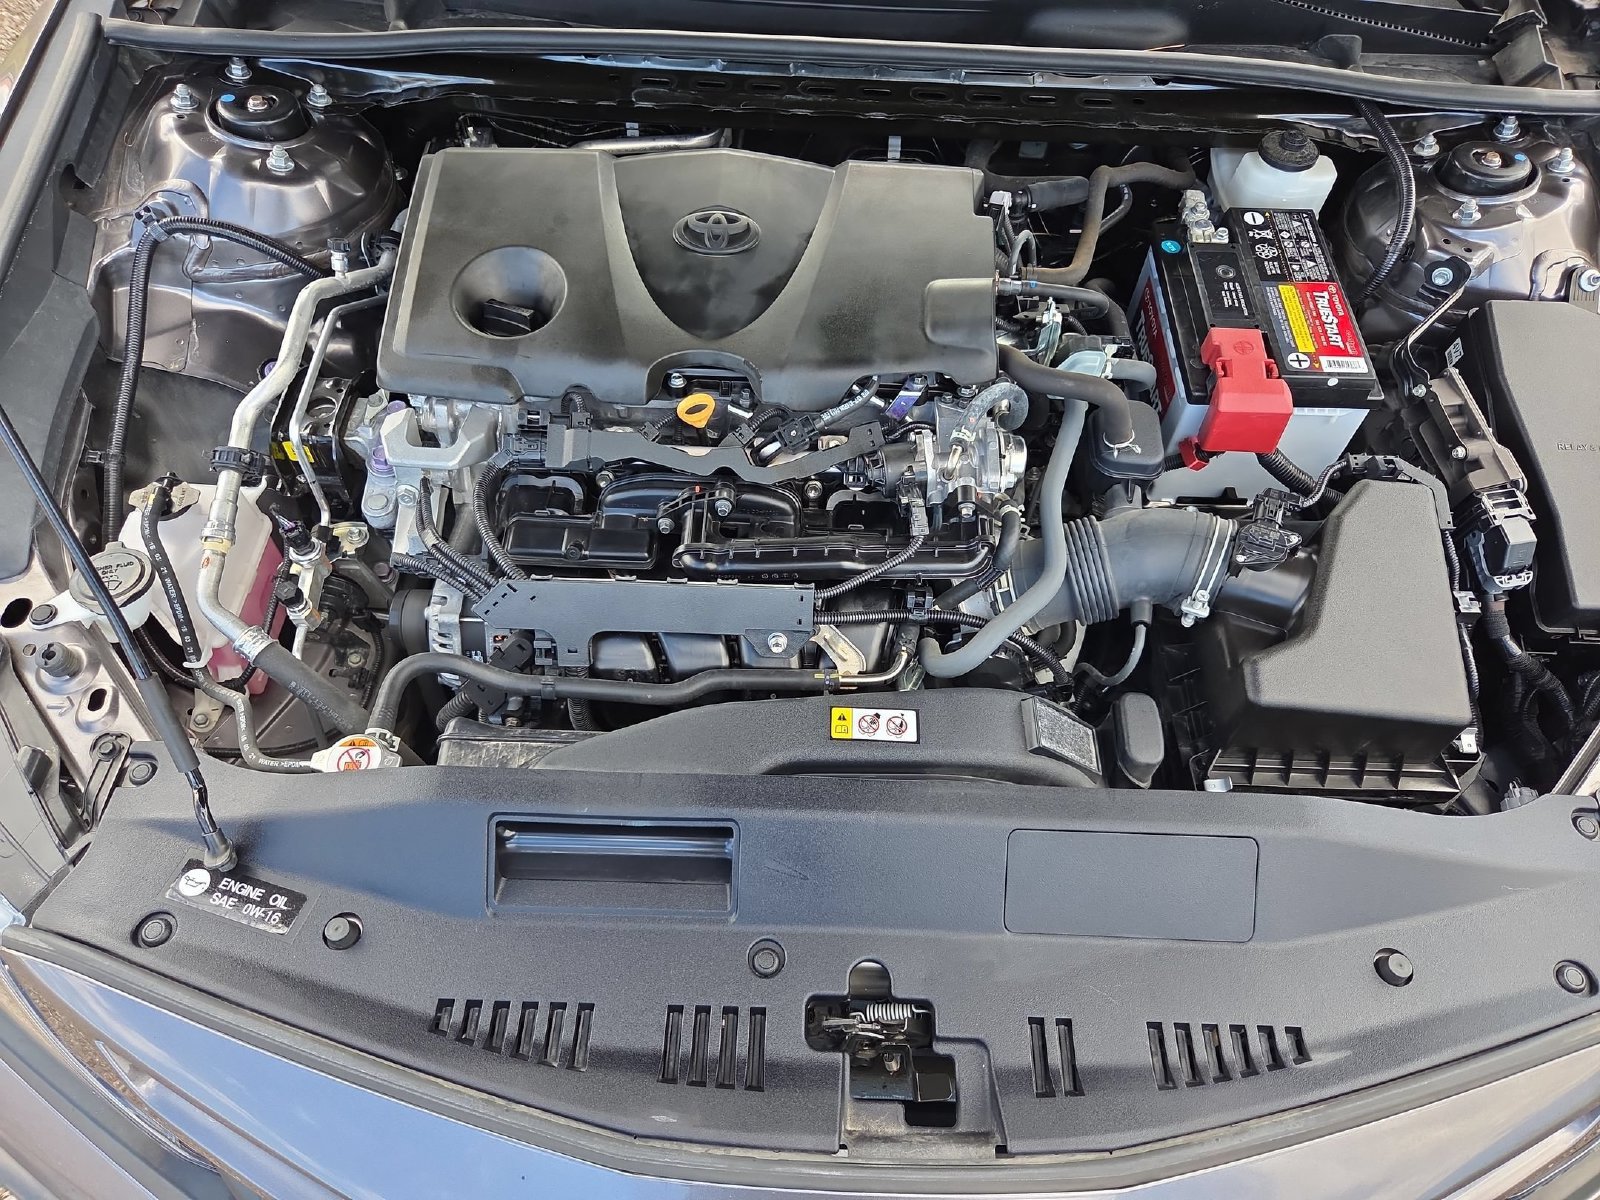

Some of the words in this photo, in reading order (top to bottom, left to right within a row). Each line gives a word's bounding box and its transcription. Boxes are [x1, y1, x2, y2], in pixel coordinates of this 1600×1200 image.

[1331, 294, 1344, 316] TOYOTA
[1557, 442, 1588, 451] RELAY
[164, 577, 177, 599] WATER
[258, 758, 279, 767] WATER
[218, 877, 265, 901] ENGINE
[269, 893, 288, 910] OIL
[209, 892, 238, 910] SAE
[242, 903, 281, 924] 0W-16
